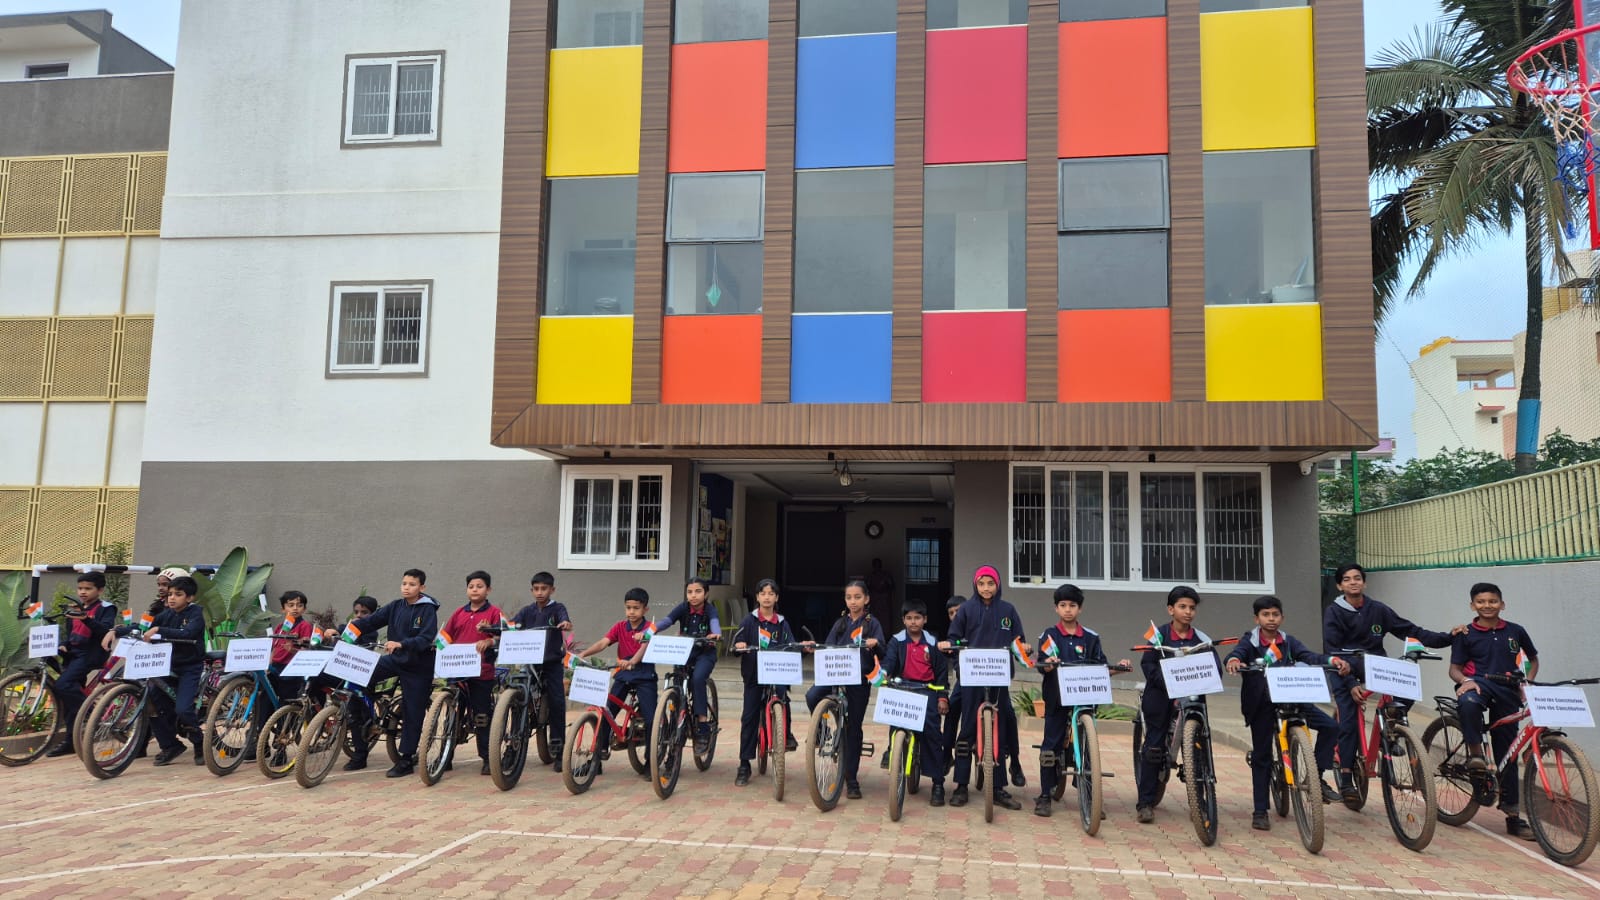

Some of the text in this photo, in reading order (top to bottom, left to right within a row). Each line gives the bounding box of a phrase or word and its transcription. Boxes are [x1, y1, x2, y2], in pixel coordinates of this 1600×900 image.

[1174, 670, 1213, 682] Beyond Self
[1078, 685, 1090, 693] Our
[1091, 684, 1108, 692] Duty
[891, 708, 903, 718] Our
[903, 711, 919, 721] Duty
